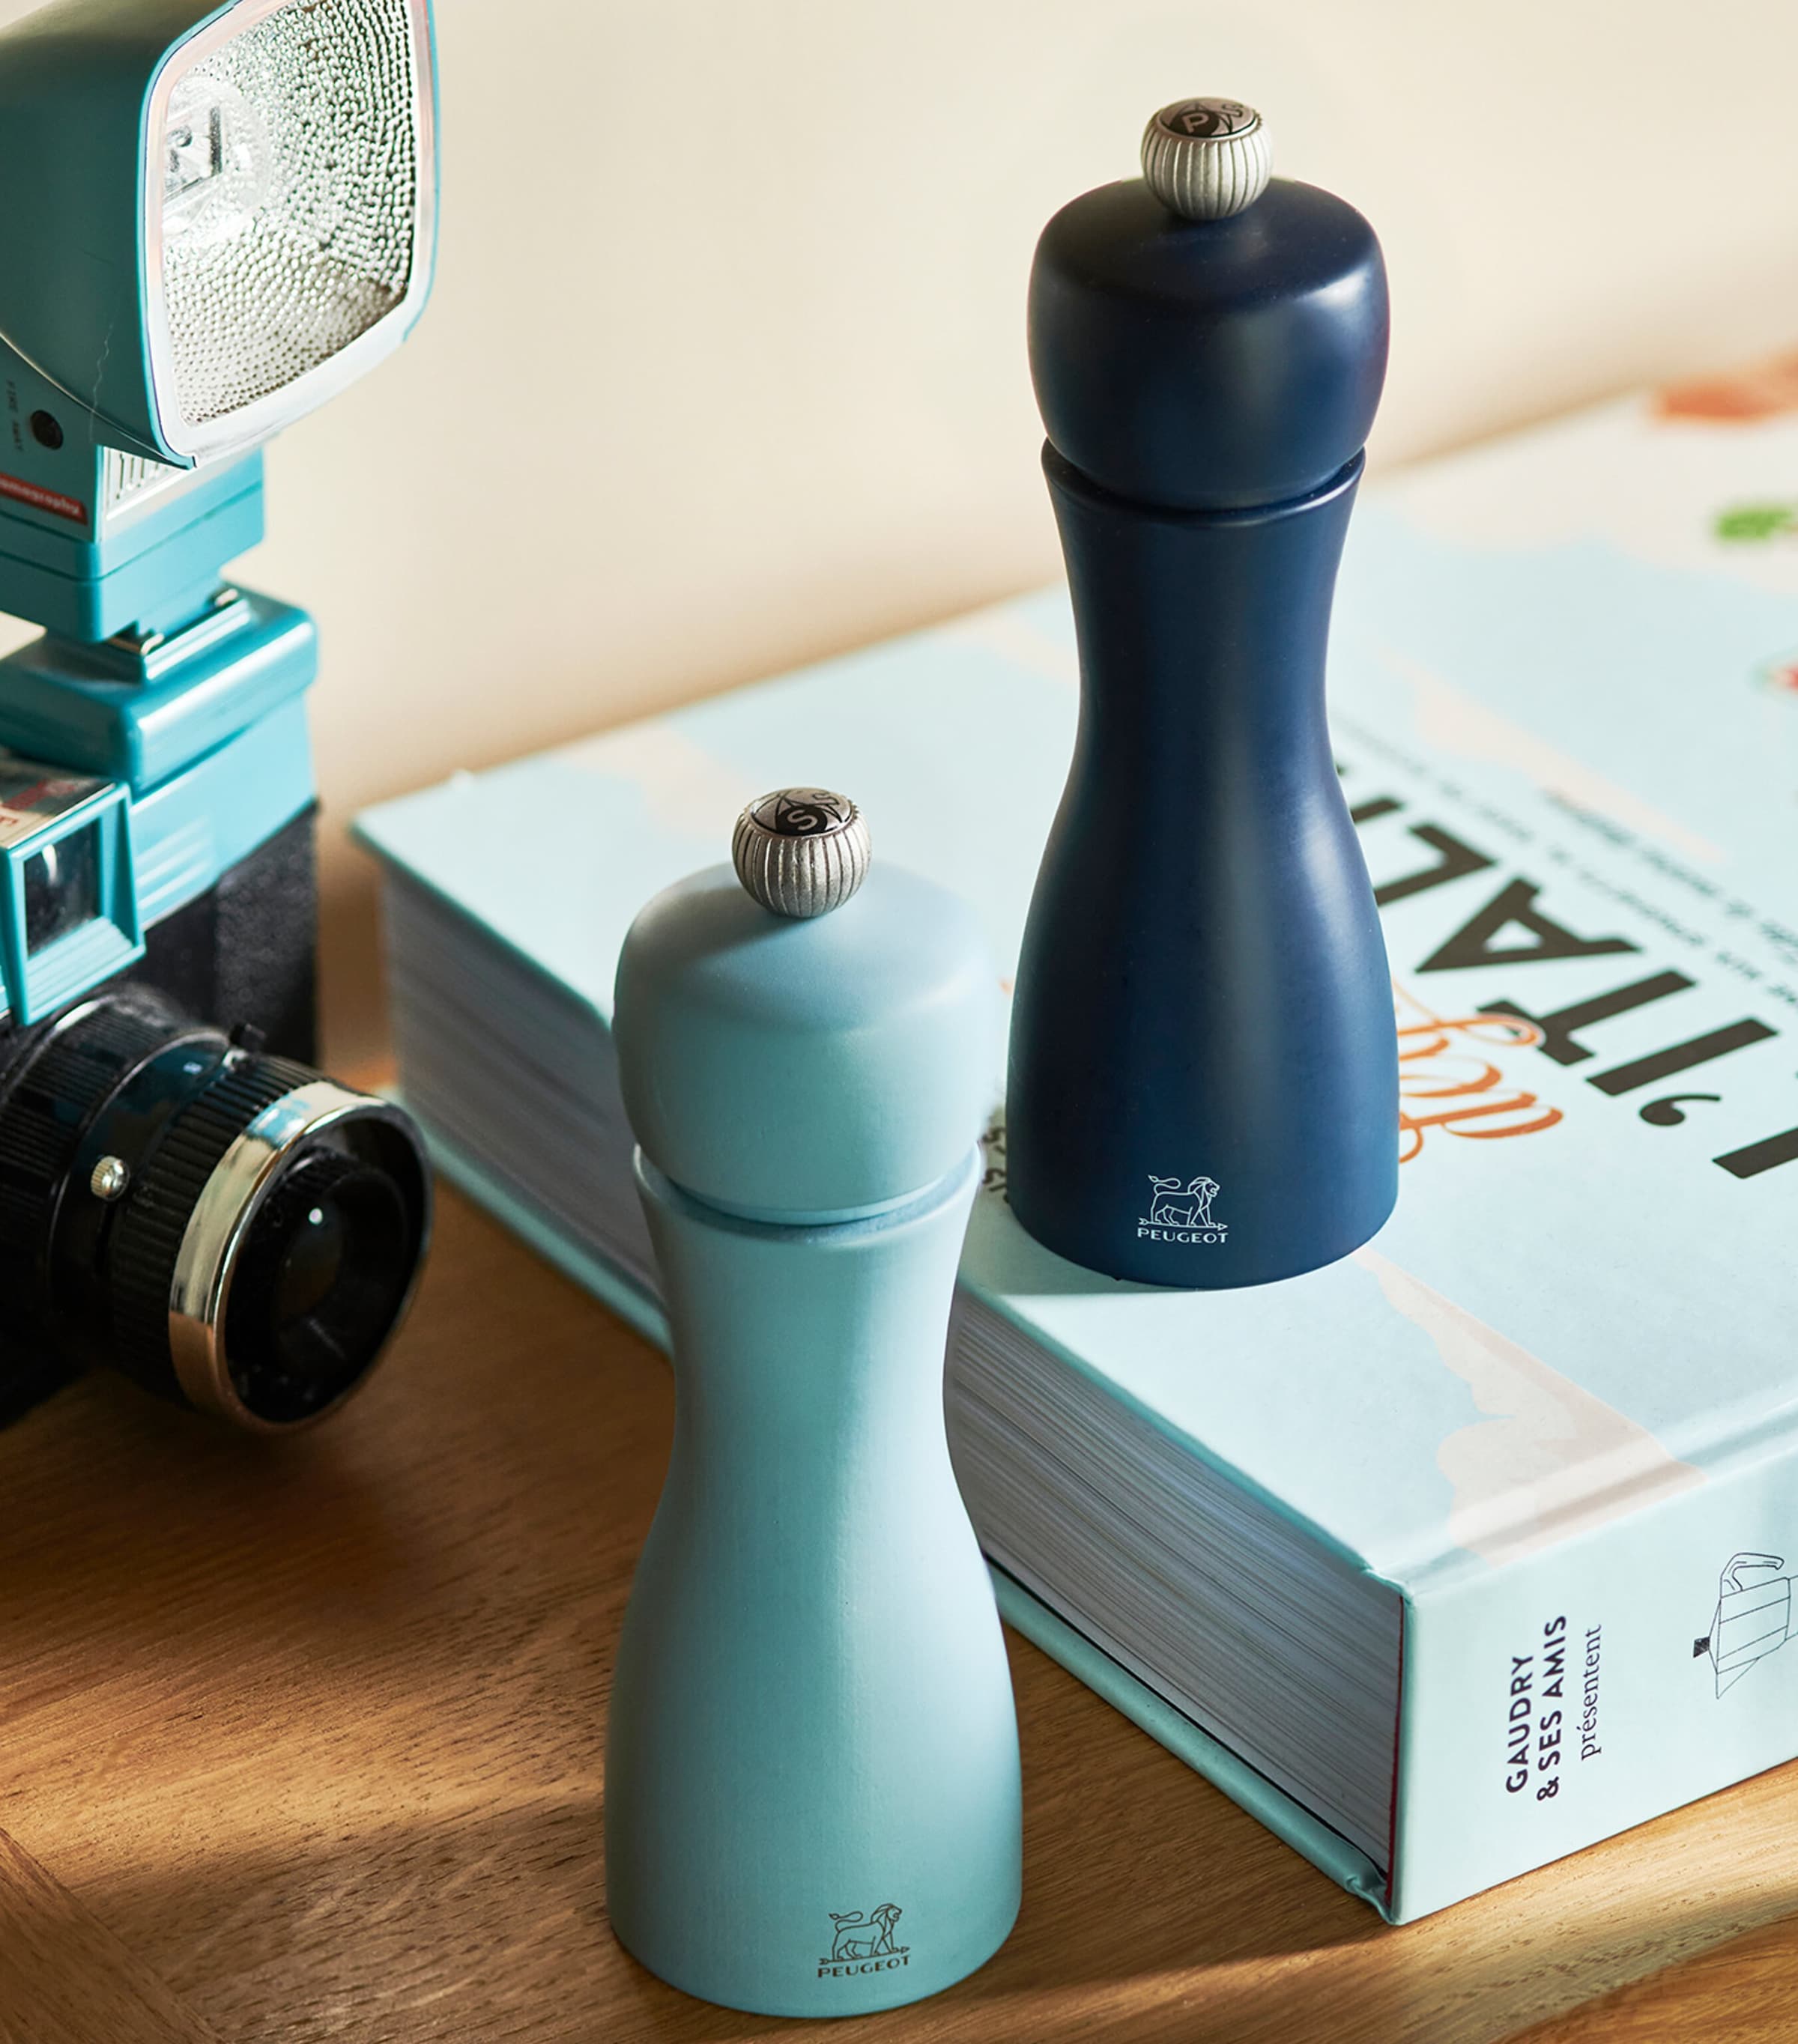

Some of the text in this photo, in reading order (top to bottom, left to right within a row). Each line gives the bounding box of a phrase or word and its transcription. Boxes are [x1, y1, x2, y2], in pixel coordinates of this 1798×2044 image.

[1181, 112, 1209, 133] P
[787, 810, 818, 831] S
[1137, 1228, 1229, 1244] PEUGEOT
[1575, 1624, 1602, 1761] présentent
[1537, 1616, 1567, 1801] & SES AMIS
[1505, 1655, 1534, 1793] GAUDRY
[817, 1956, 911, 1977] PEUGEOT
